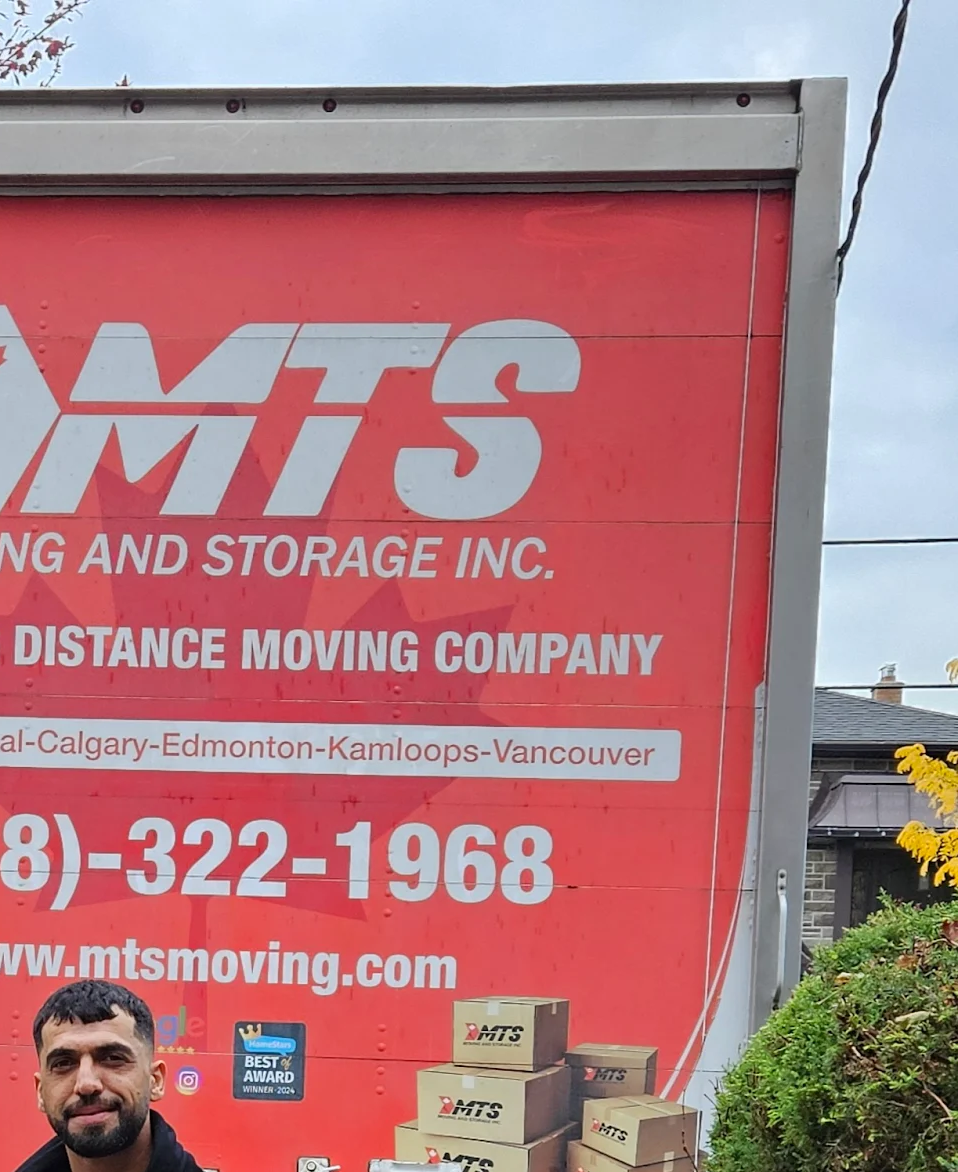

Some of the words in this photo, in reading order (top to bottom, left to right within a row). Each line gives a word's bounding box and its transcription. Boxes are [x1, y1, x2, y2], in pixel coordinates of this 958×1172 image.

[20, 318, 582, 520] MTS
[77, 533, 189, 576] AND
[200, 534, 443, 580] STORAGE
[454, 536, 555, 580] INC.
[13, 624, 226, 670] DISTANCE
[241, 628, 420, 673] MOVING
[433, 631, 664, 676] COMPANY
[477, 1024, 525, 1043] MTS
[244, 1055, 279, 1069] BEST
[280, 1055, 293, 1071] of
[243, 1070, 295, 1084] AWARD
[594, 1067, 627, 1082] MTS
[452, 1099, 503, 1119] MTS
[598, 1122, 629, 1142] MTS
